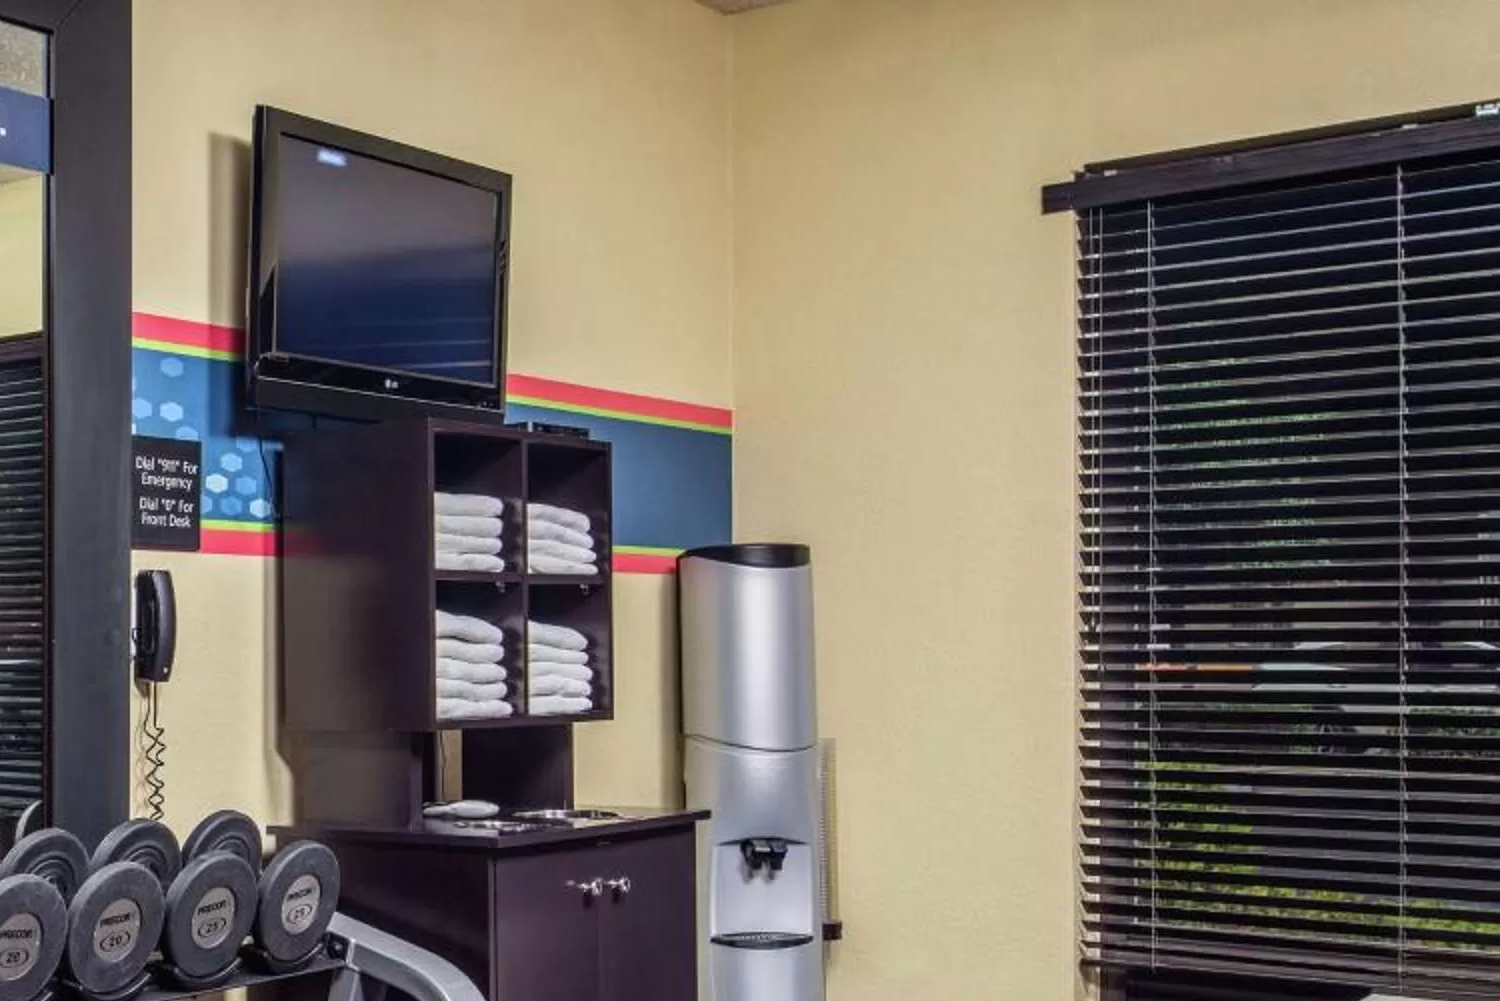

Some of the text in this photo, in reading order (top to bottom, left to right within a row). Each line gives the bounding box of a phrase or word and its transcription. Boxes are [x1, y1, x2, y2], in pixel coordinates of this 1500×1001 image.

[135, 456, 155, 471] Dial
[183, 461, 198, 475] For
[141, 472, 192, 492] Emergency
[140, 497, 159, 511] Dial
[178, 500, 195, 513] For
[141, 511, 191, 528] Front Desk
[206, 920, 219, 933] 25
[109, 933, 123, 946] 20
[6, 950, 21, 964] 20
